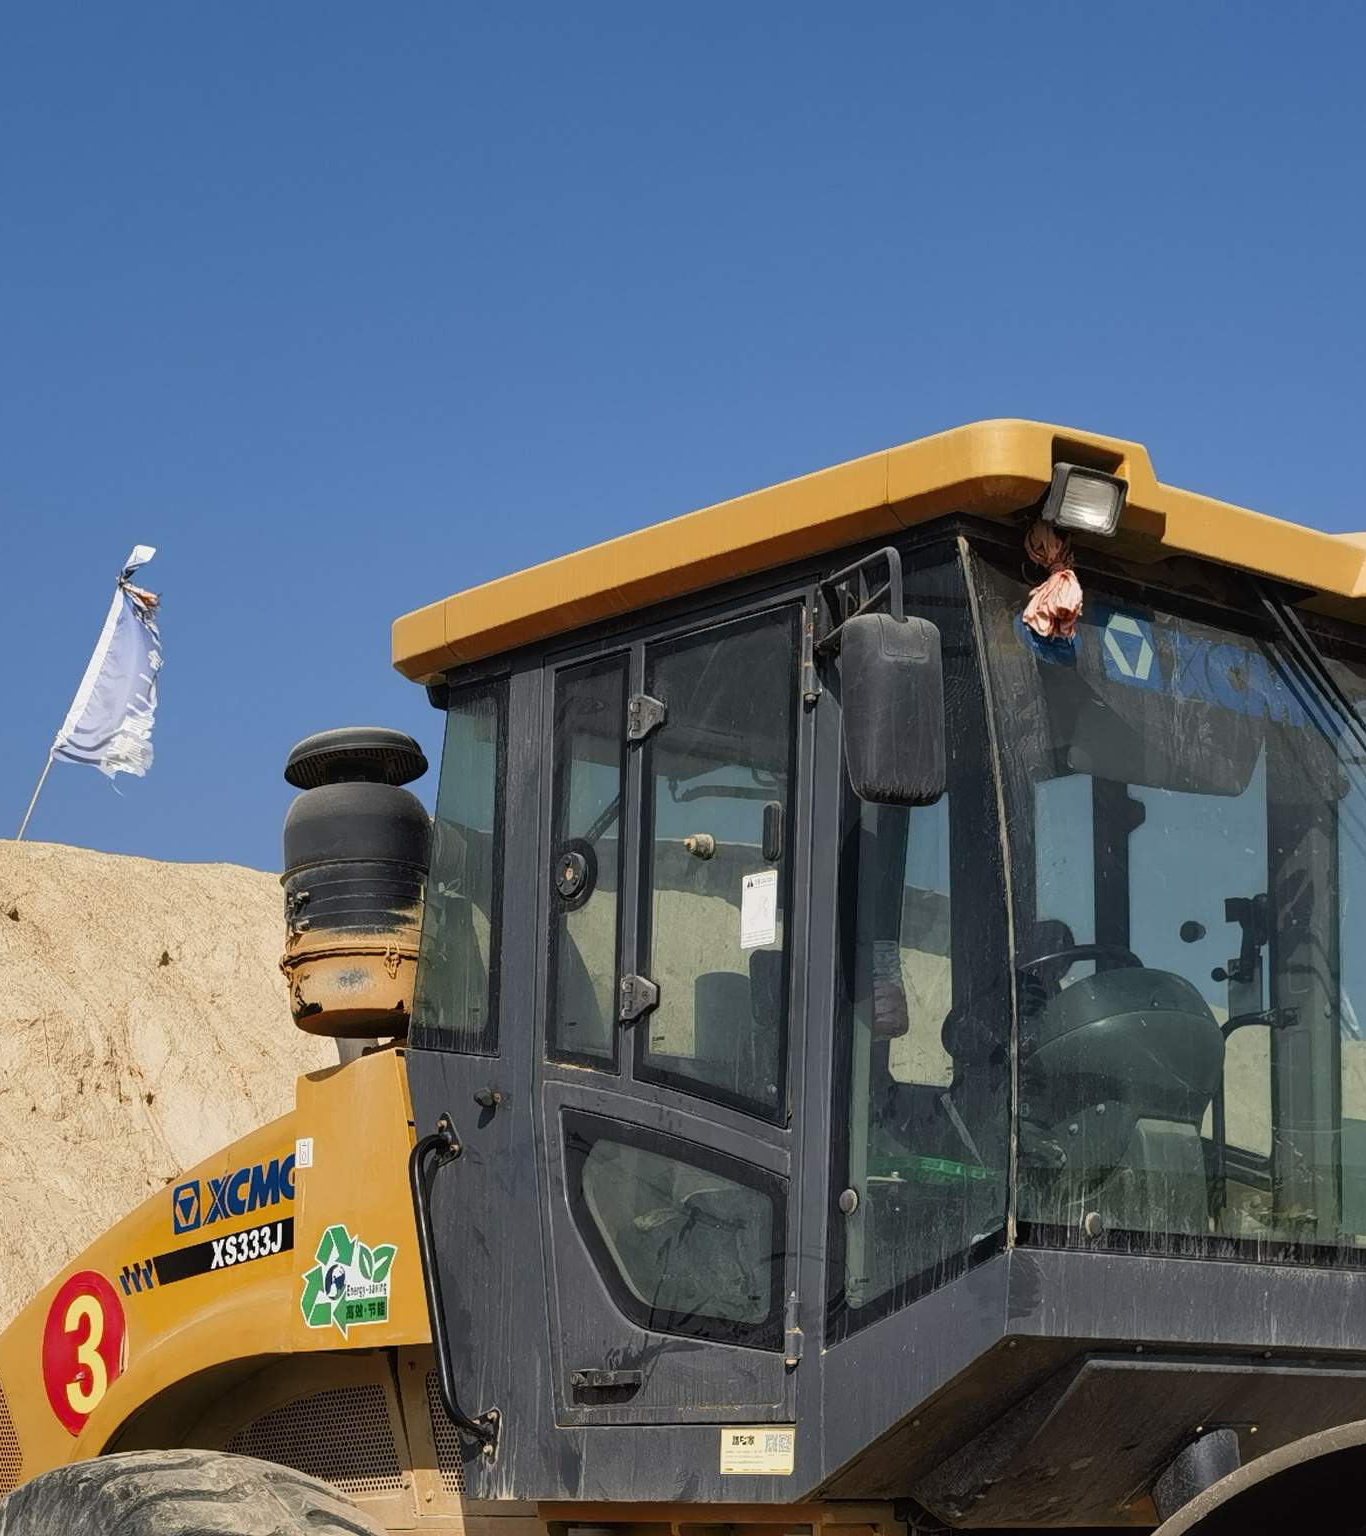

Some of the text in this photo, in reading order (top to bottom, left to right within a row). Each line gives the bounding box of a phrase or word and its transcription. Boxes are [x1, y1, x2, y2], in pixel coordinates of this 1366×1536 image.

[1169, 630, 1347, 737] XCM
[211, 1223, 283, 1270] XS333J
[64, 1295, 107, 1414] 3
